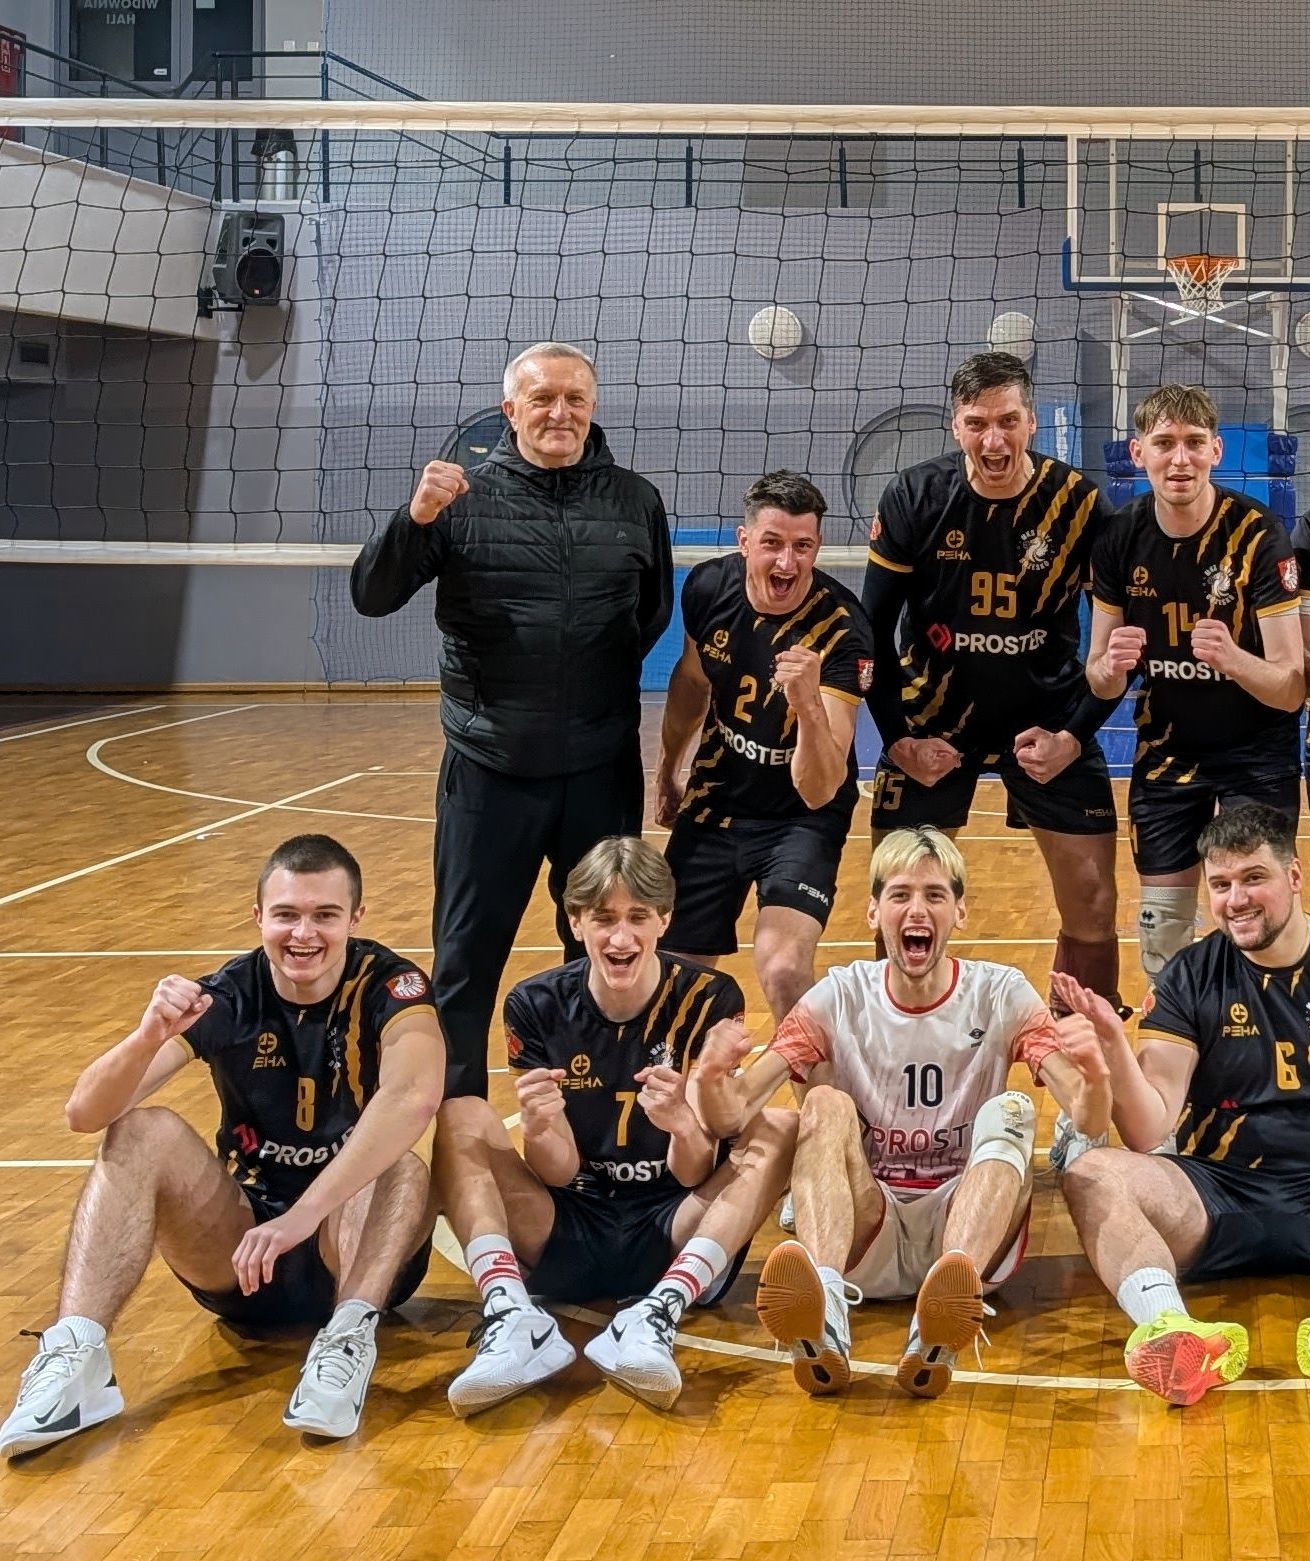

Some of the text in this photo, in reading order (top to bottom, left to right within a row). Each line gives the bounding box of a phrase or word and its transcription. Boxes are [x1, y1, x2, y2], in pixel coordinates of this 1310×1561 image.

[937, 550, 972, 561] PEHA
[971, 572, 1017, 619] 95
[1126, 586, 1158, 598] PEHA
[1162, 602, 1200, 647] 14
[702, 643, 732, 665] PEHA
[955, 629, 1048, 655] PROSTER
[1149, 660, 1235, 682] PROS
[734, 674, 758, 724] 2
[1222, 1025, 1261, 1037] PEHA
[252, 1056, 287, 1070] EHA
[1275, 1040, 1301, 1090] 6
[559, 1077, 604, 1089] PEHA
[903, 1063, 944, 1108] 10
[296, 1077, 316, 1132] 8
[616, 1091, 636, 1147] 7
[589, 1159, 669, 1182] PROST
